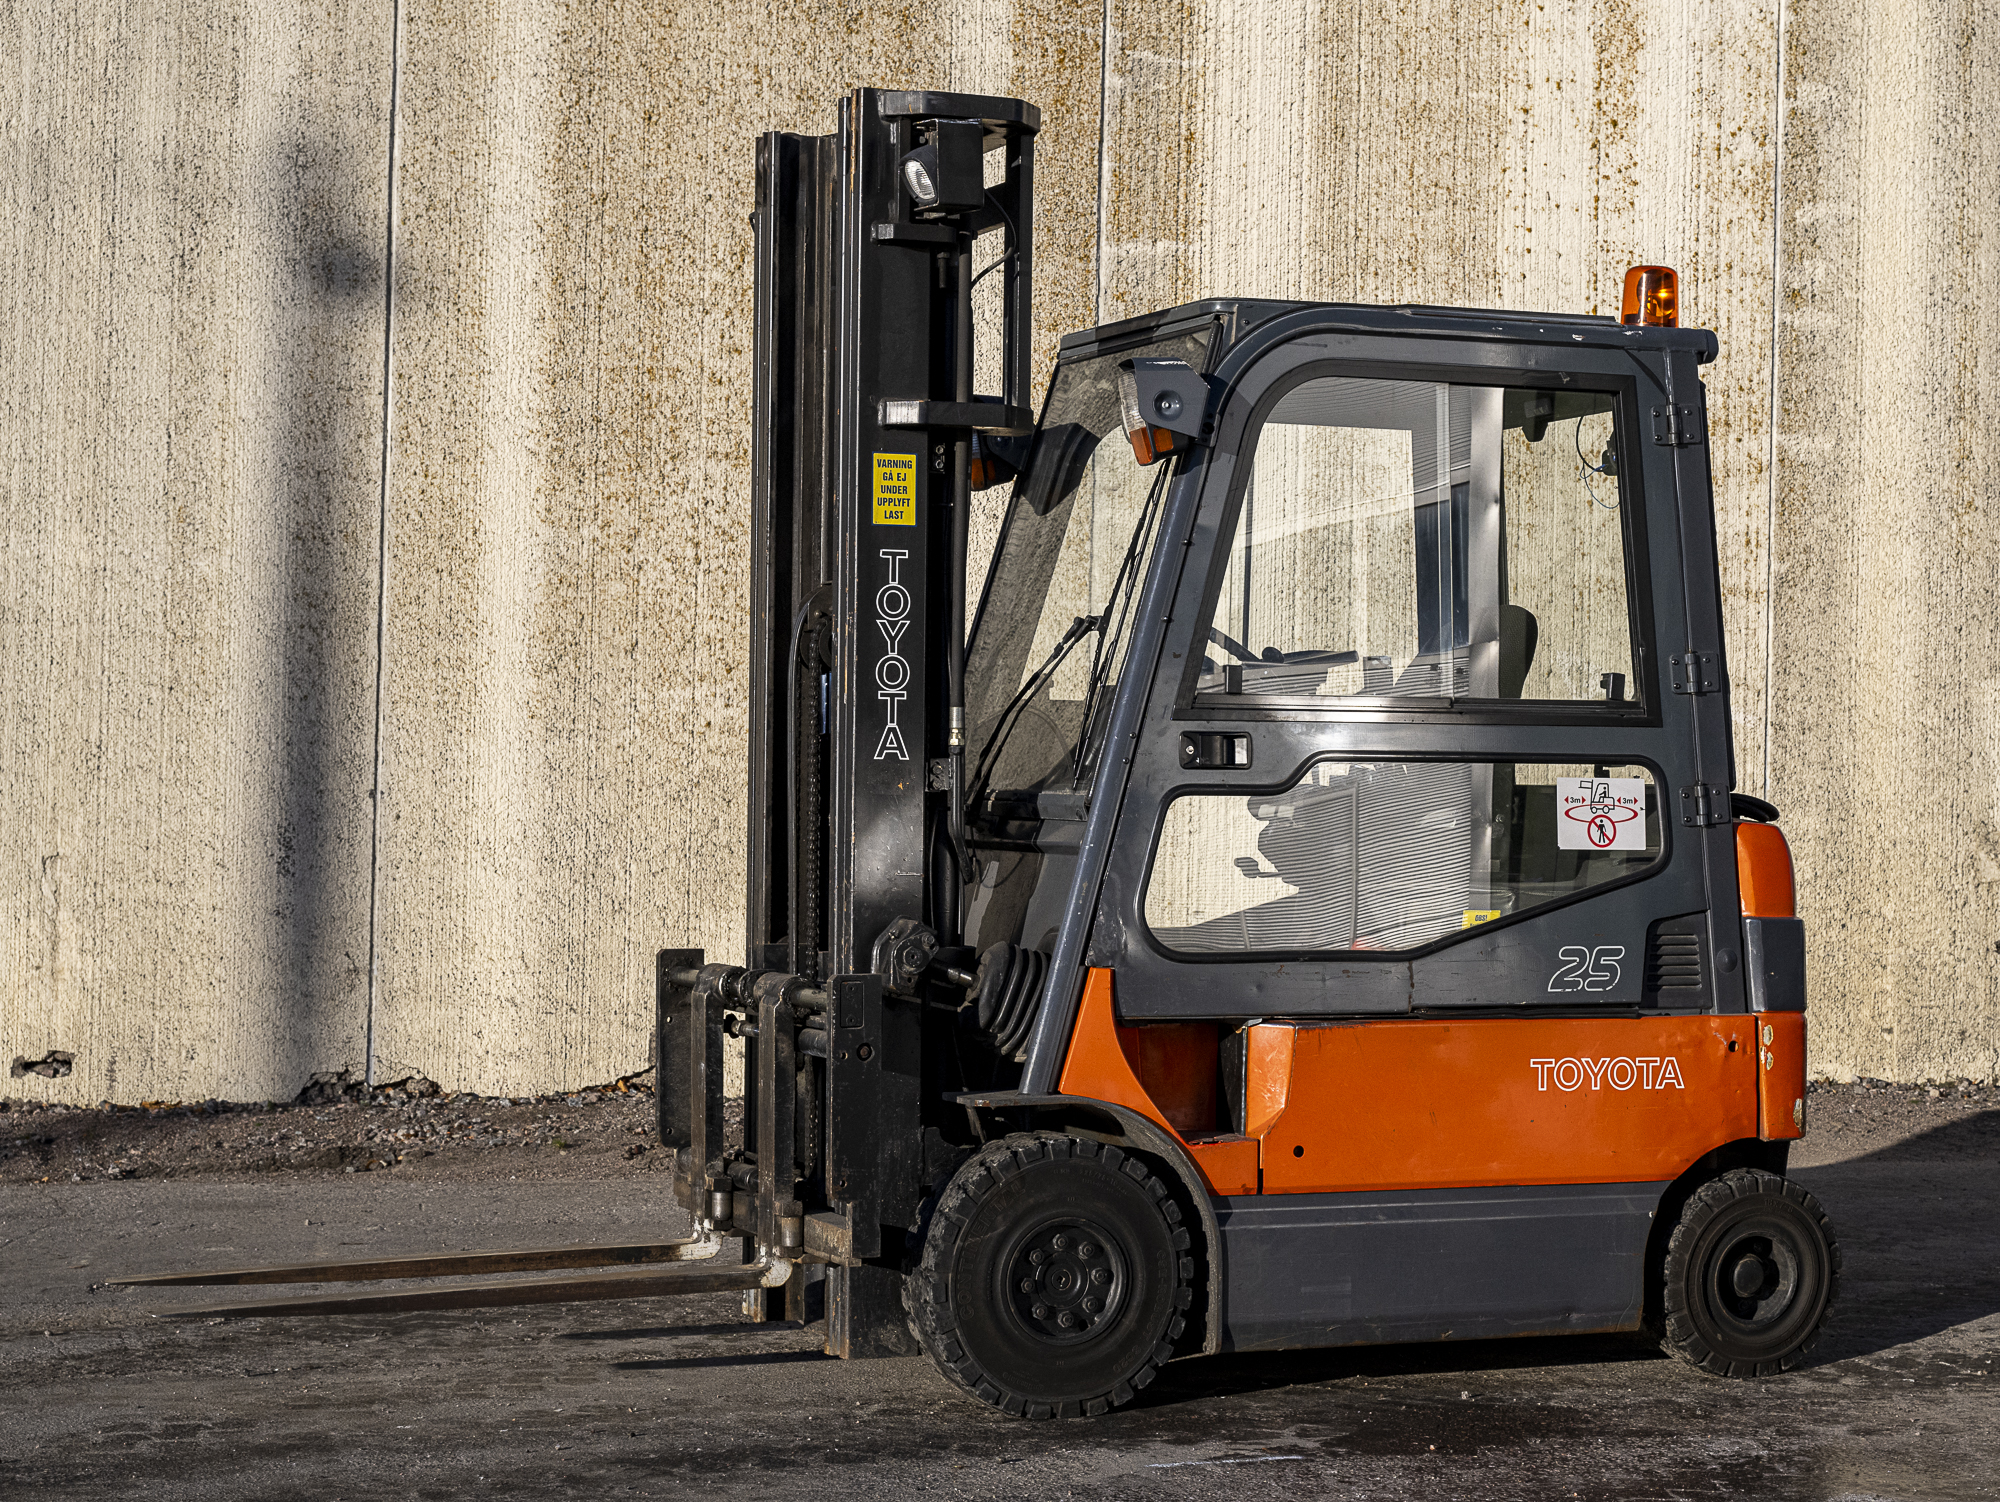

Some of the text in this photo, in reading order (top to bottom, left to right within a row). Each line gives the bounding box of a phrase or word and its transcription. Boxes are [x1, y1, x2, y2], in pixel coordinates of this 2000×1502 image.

[877, 459, 912, 469] VARNING
[883, 470, 907, 481] GÅ EJ
[881, 485, 908, 494] UNDER
[877, 497, 911, 507] UPPLYFT
[884, 510, 904, 519] LAST
[874, 549, 911, 760] TOYOTA
[1570, 796, 1581, 804] 3m
[1622, 797, 1633, 805] 3m
[1548, 945, 1625, 992] 25
[1530, 1056, 1685, 1092] TOYOTA
[957, 1181, 1026, 1320] CONTINENTAL
